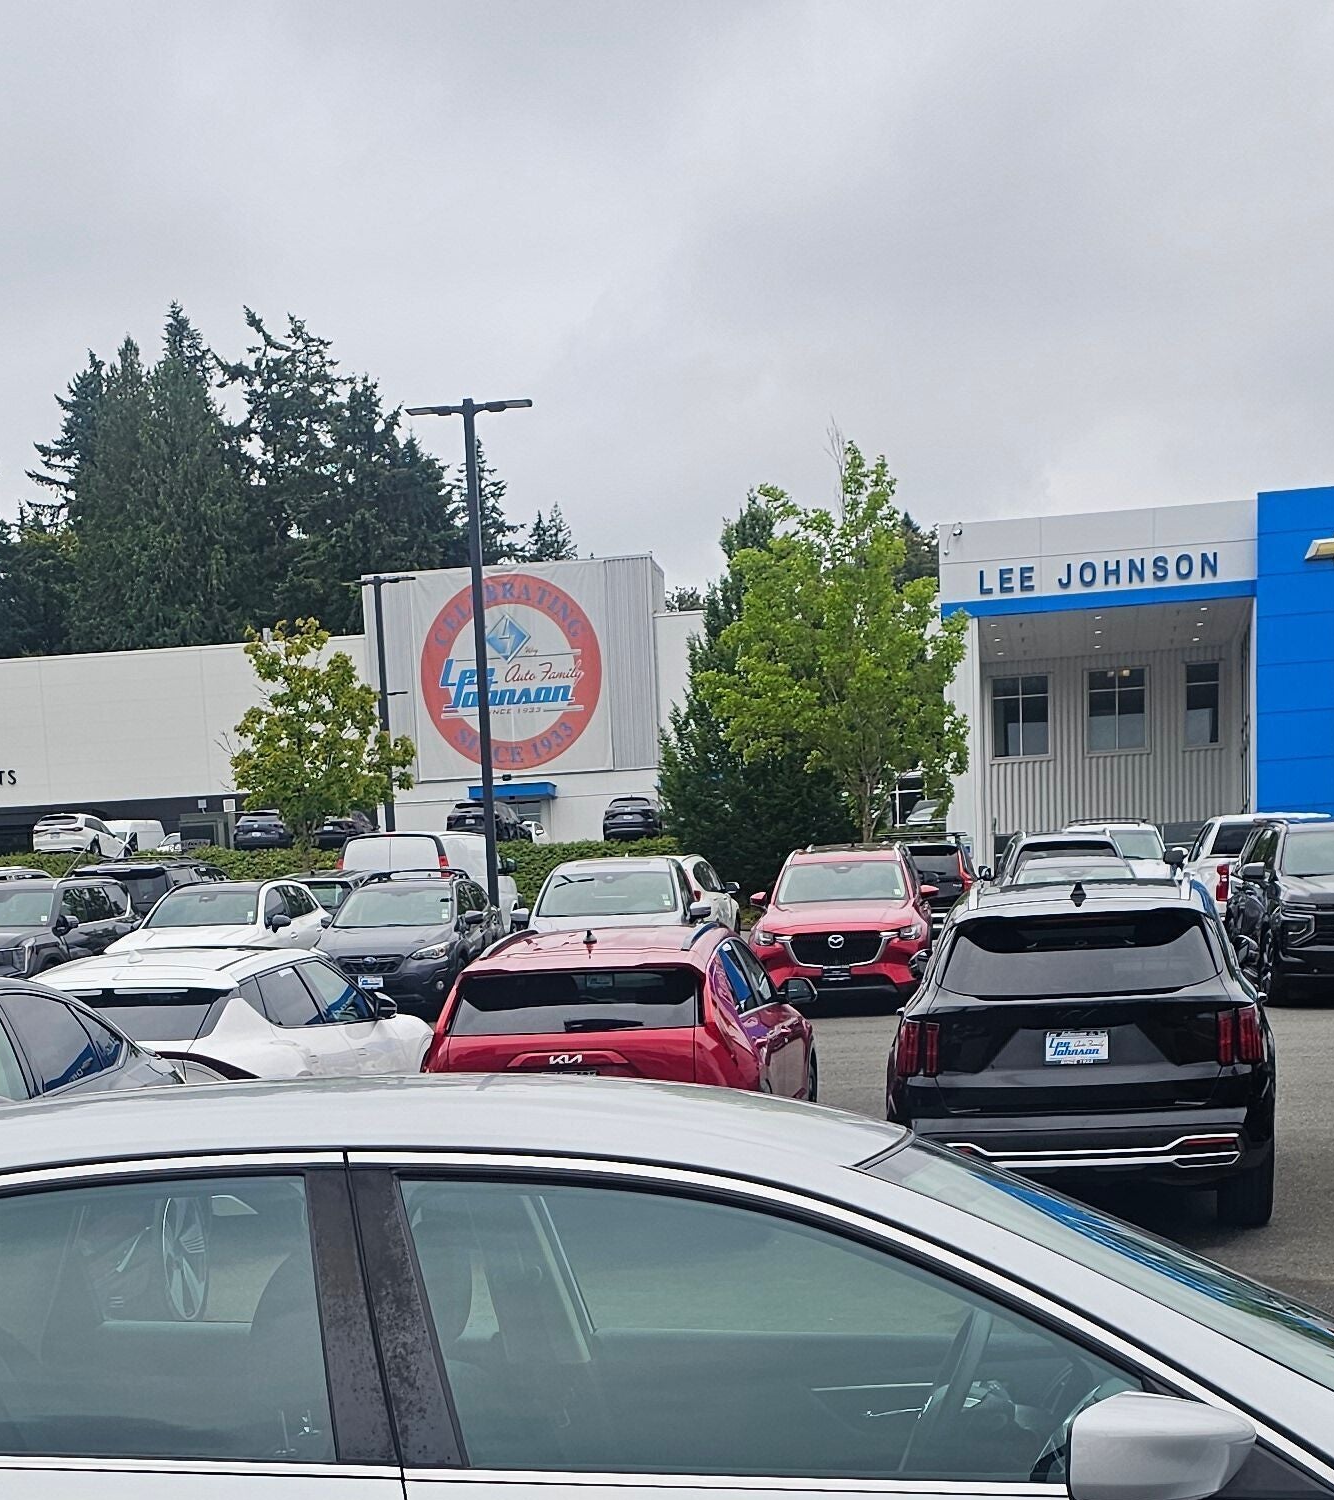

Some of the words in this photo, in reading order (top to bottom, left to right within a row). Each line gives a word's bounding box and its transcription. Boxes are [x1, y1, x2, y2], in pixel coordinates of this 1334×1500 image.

[979, 566, 1035, 595] LEE
[1058, 551, 1218, 589] JOHNSON
[434, 580, 586, 646] CELBRATING
[504, 663, 537, 684] Auto
[538, 659, 585, 687] Family
[455, 728, 525, 763] SICE
[1049, 1038, 1071, 1048] Lee
[1050, 1046, 1100, 1056] Johnson
[549, 1054, 583, 1065] KIA
